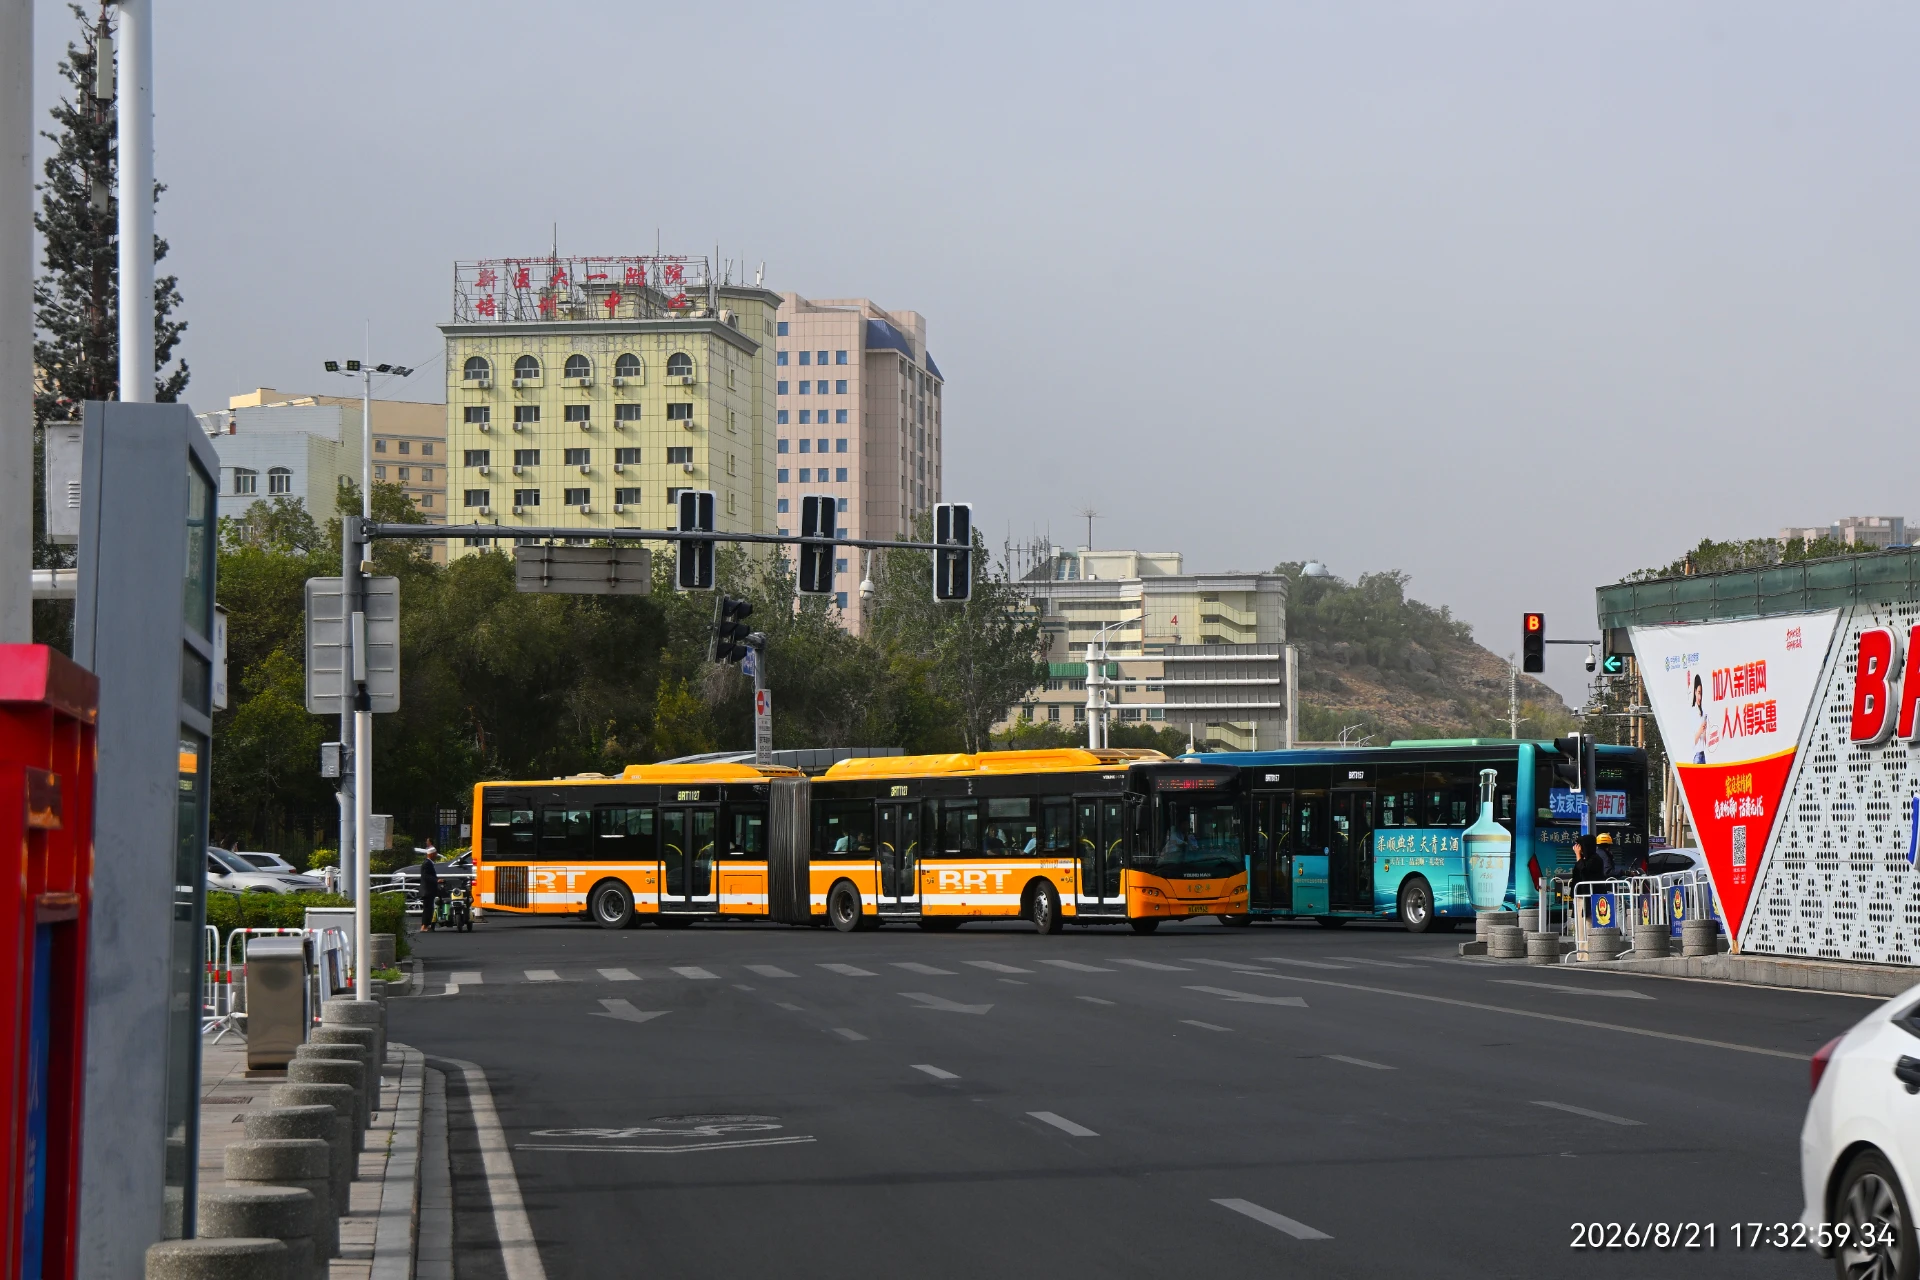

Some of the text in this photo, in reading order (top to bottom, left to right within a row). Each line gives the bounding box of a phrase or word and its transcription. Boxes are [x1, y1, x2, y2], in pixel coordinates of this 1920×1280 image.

[475, 264, 687, 292] 新医大一附院
[475, 293, 687, 318] 培训中心
[1170, 614, 1179, 626] 4
[1529, 615, 1540, 631] B
[1712, 660, 1767, 701] 加入亲情网
[1721, 699, 1777, 739] 人人得实惠
[677, 790, 700, 801] BRT1127
[1549, 793, 1584, 814] 全友家居
[1377, 834, 1459, 855] 柔顺典范 天青王酒
[1608, 831, 1642, 846] 青王酒
[939, 870, 1012, 894] BRT
